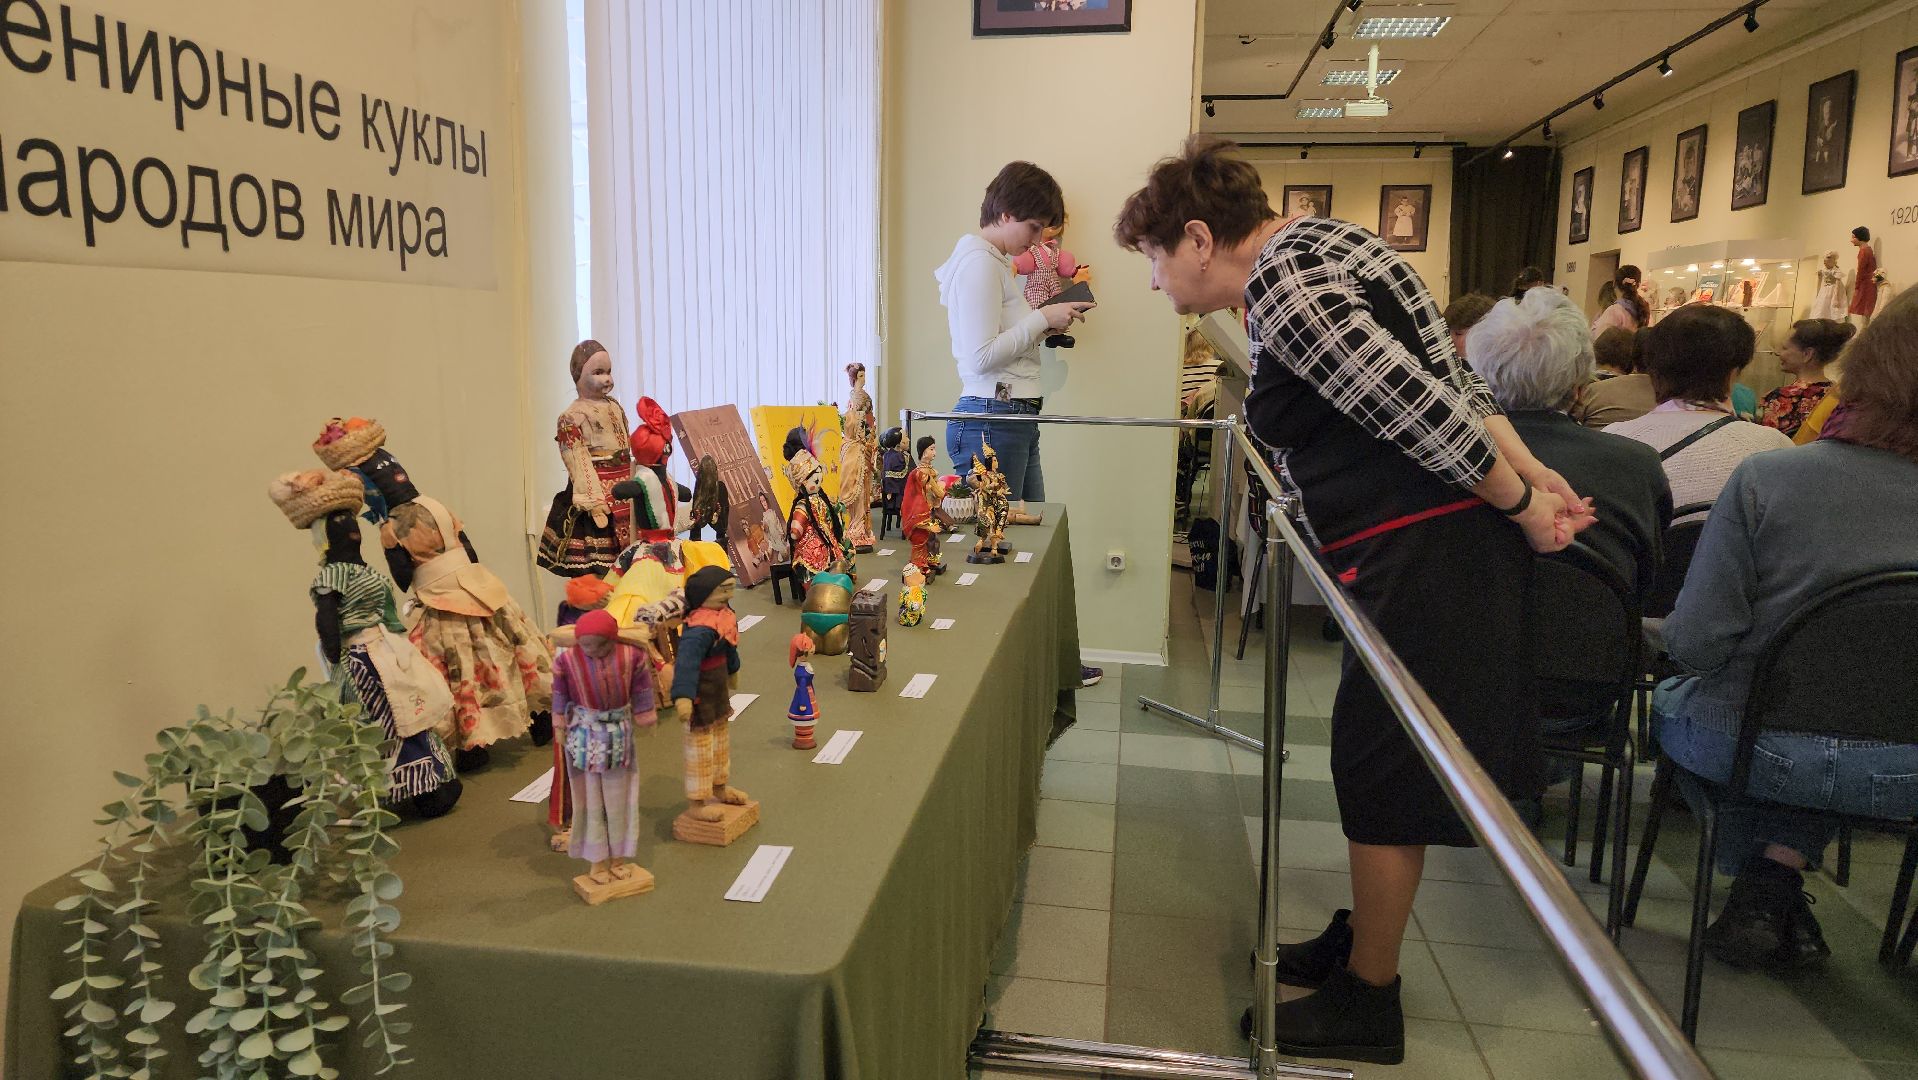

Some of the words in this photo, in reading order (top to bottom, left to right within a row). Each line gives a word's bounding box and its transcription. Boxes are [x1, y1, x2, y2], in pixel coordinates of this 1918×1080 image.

[0, 0, 341, 142] енирные
[361, 93, 488, 177] куклы
[0, 134, 305, 253] ародов
[327, 189, 449, 271] мира
